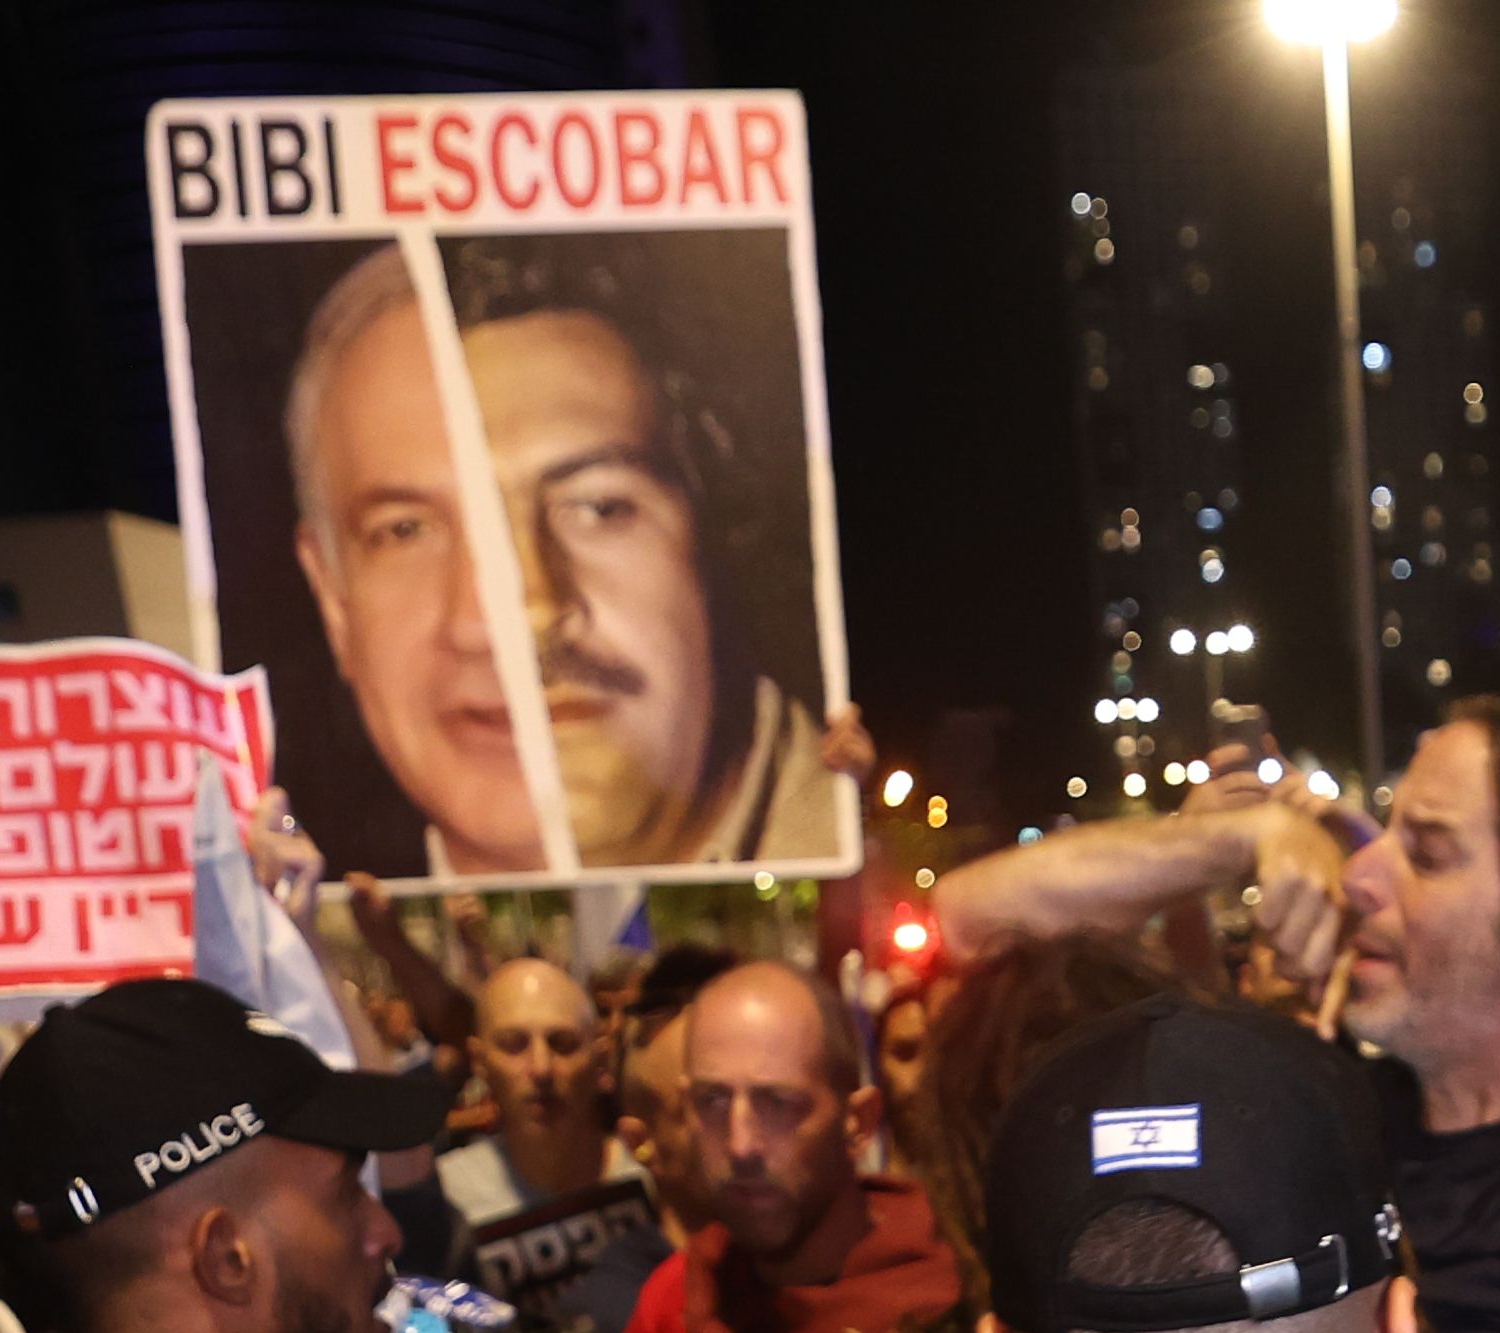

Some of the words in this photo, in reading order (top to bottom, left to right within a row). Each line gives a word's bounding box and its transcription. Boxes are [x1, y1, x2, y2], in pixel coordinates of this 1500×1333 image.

[165, 116, 343, 222] BIBI
[374, 105, 793, 217] ESCOBAR
[133, 1101, 266, 1190] POLICE
